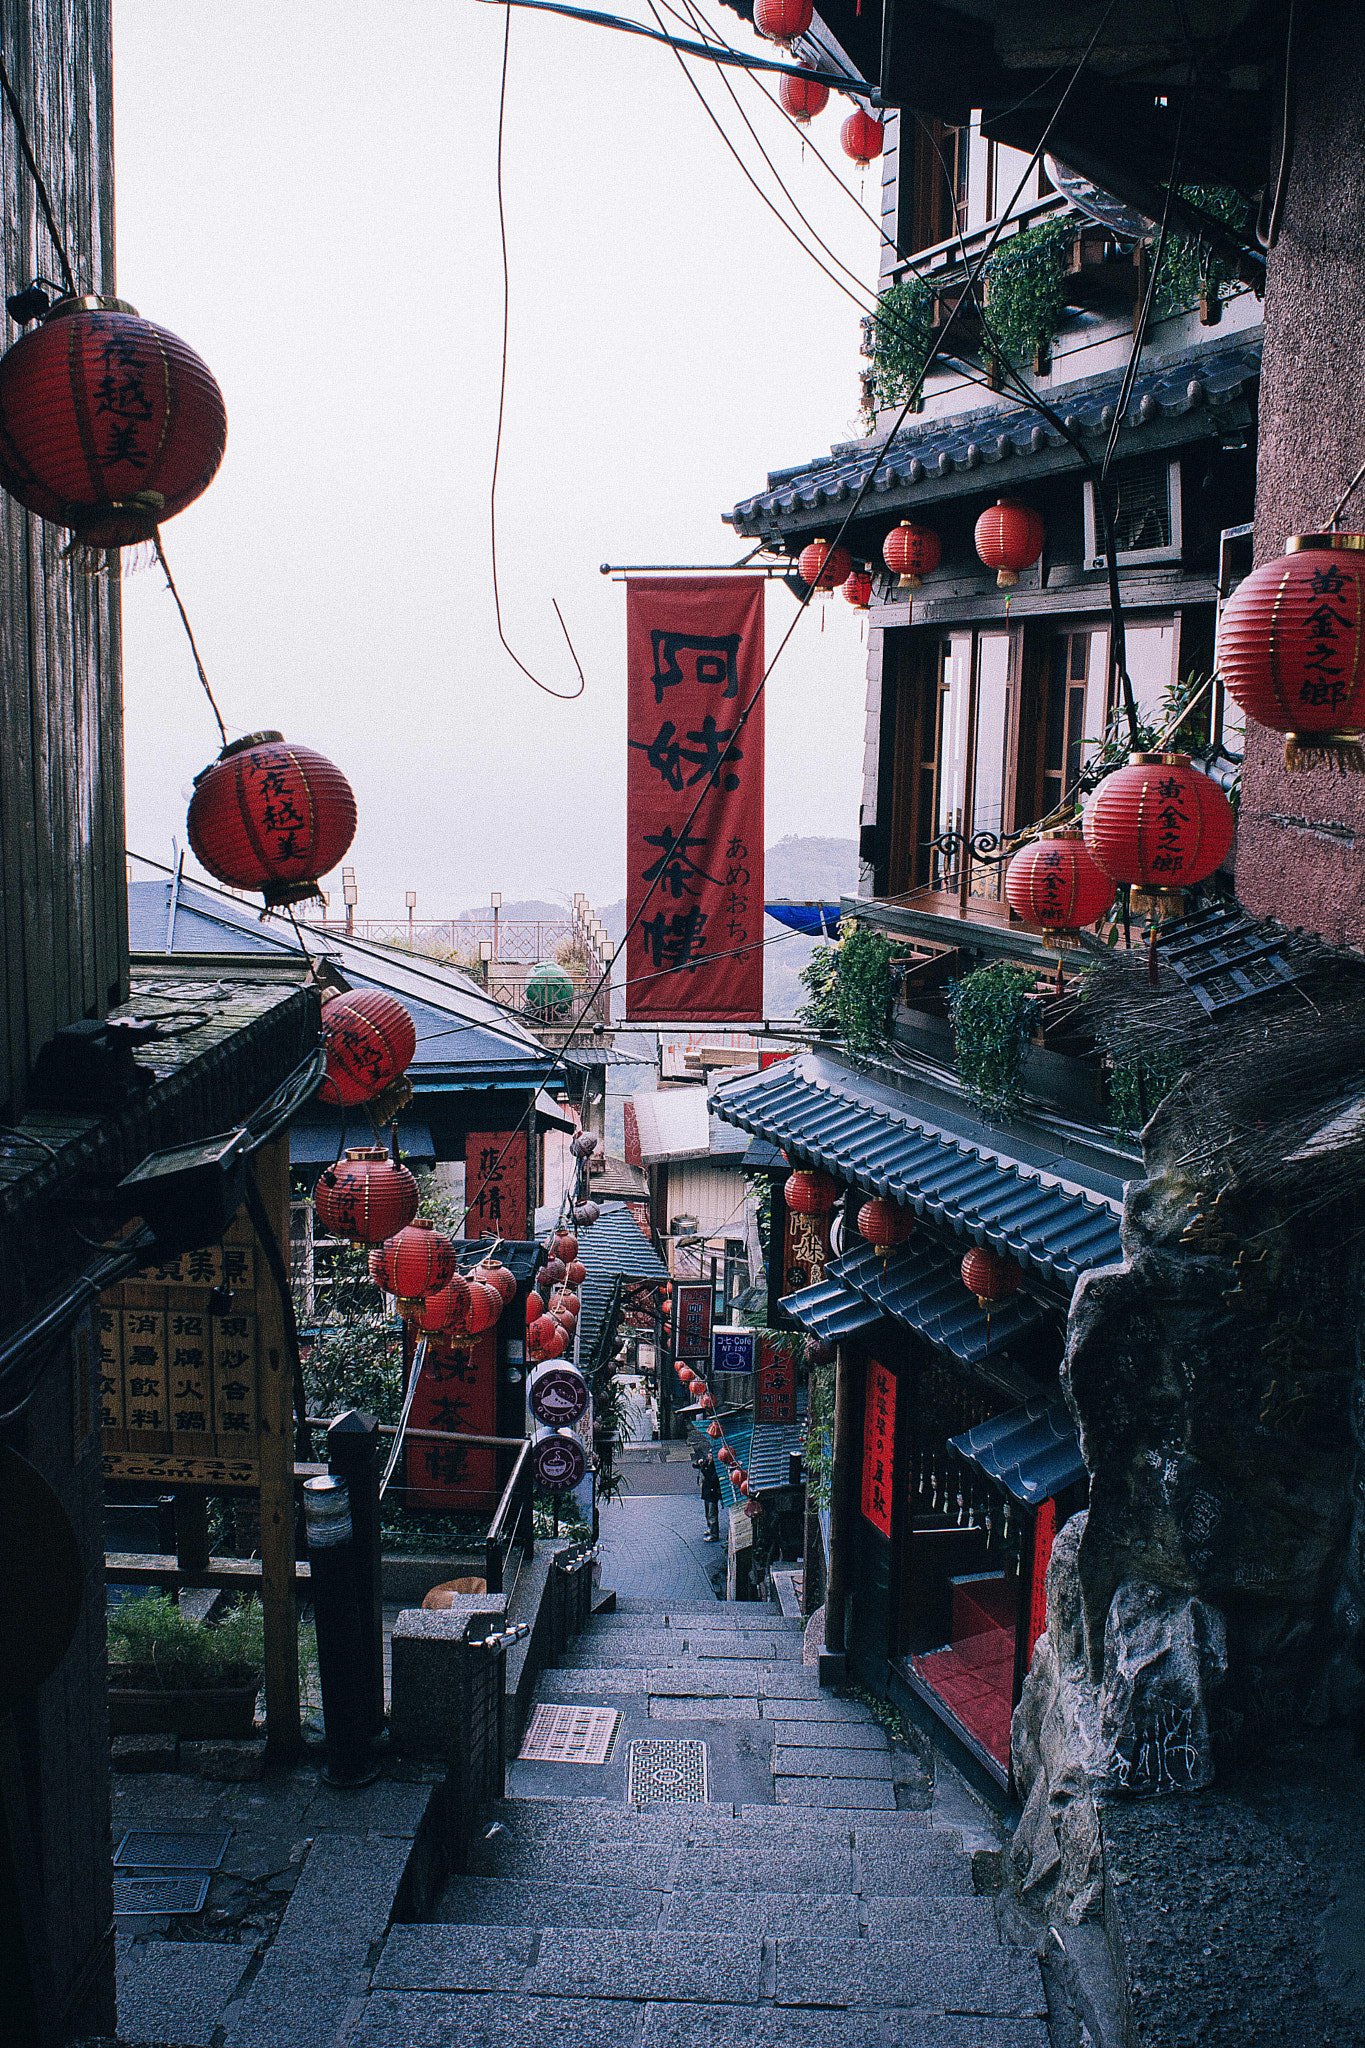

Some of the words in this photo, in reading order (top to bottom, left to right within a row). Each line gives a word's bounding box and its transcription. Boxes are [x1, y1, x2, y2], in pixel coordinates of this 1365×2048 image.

[1299, 565, 1355, 713] 黃金之鄉
[628, 629, 743, 974] 阿妹茶樓
[1152, 777, 1190, 874] 黃金之鄉
[128, 1314, 162, 1429] 消暑飲料
[173, 1315, 207, 1431] 招牌火鍋
[220, 1317, 251, 1433] 現炒合菜
[536, 1402, 583, 1422] OCARINA
